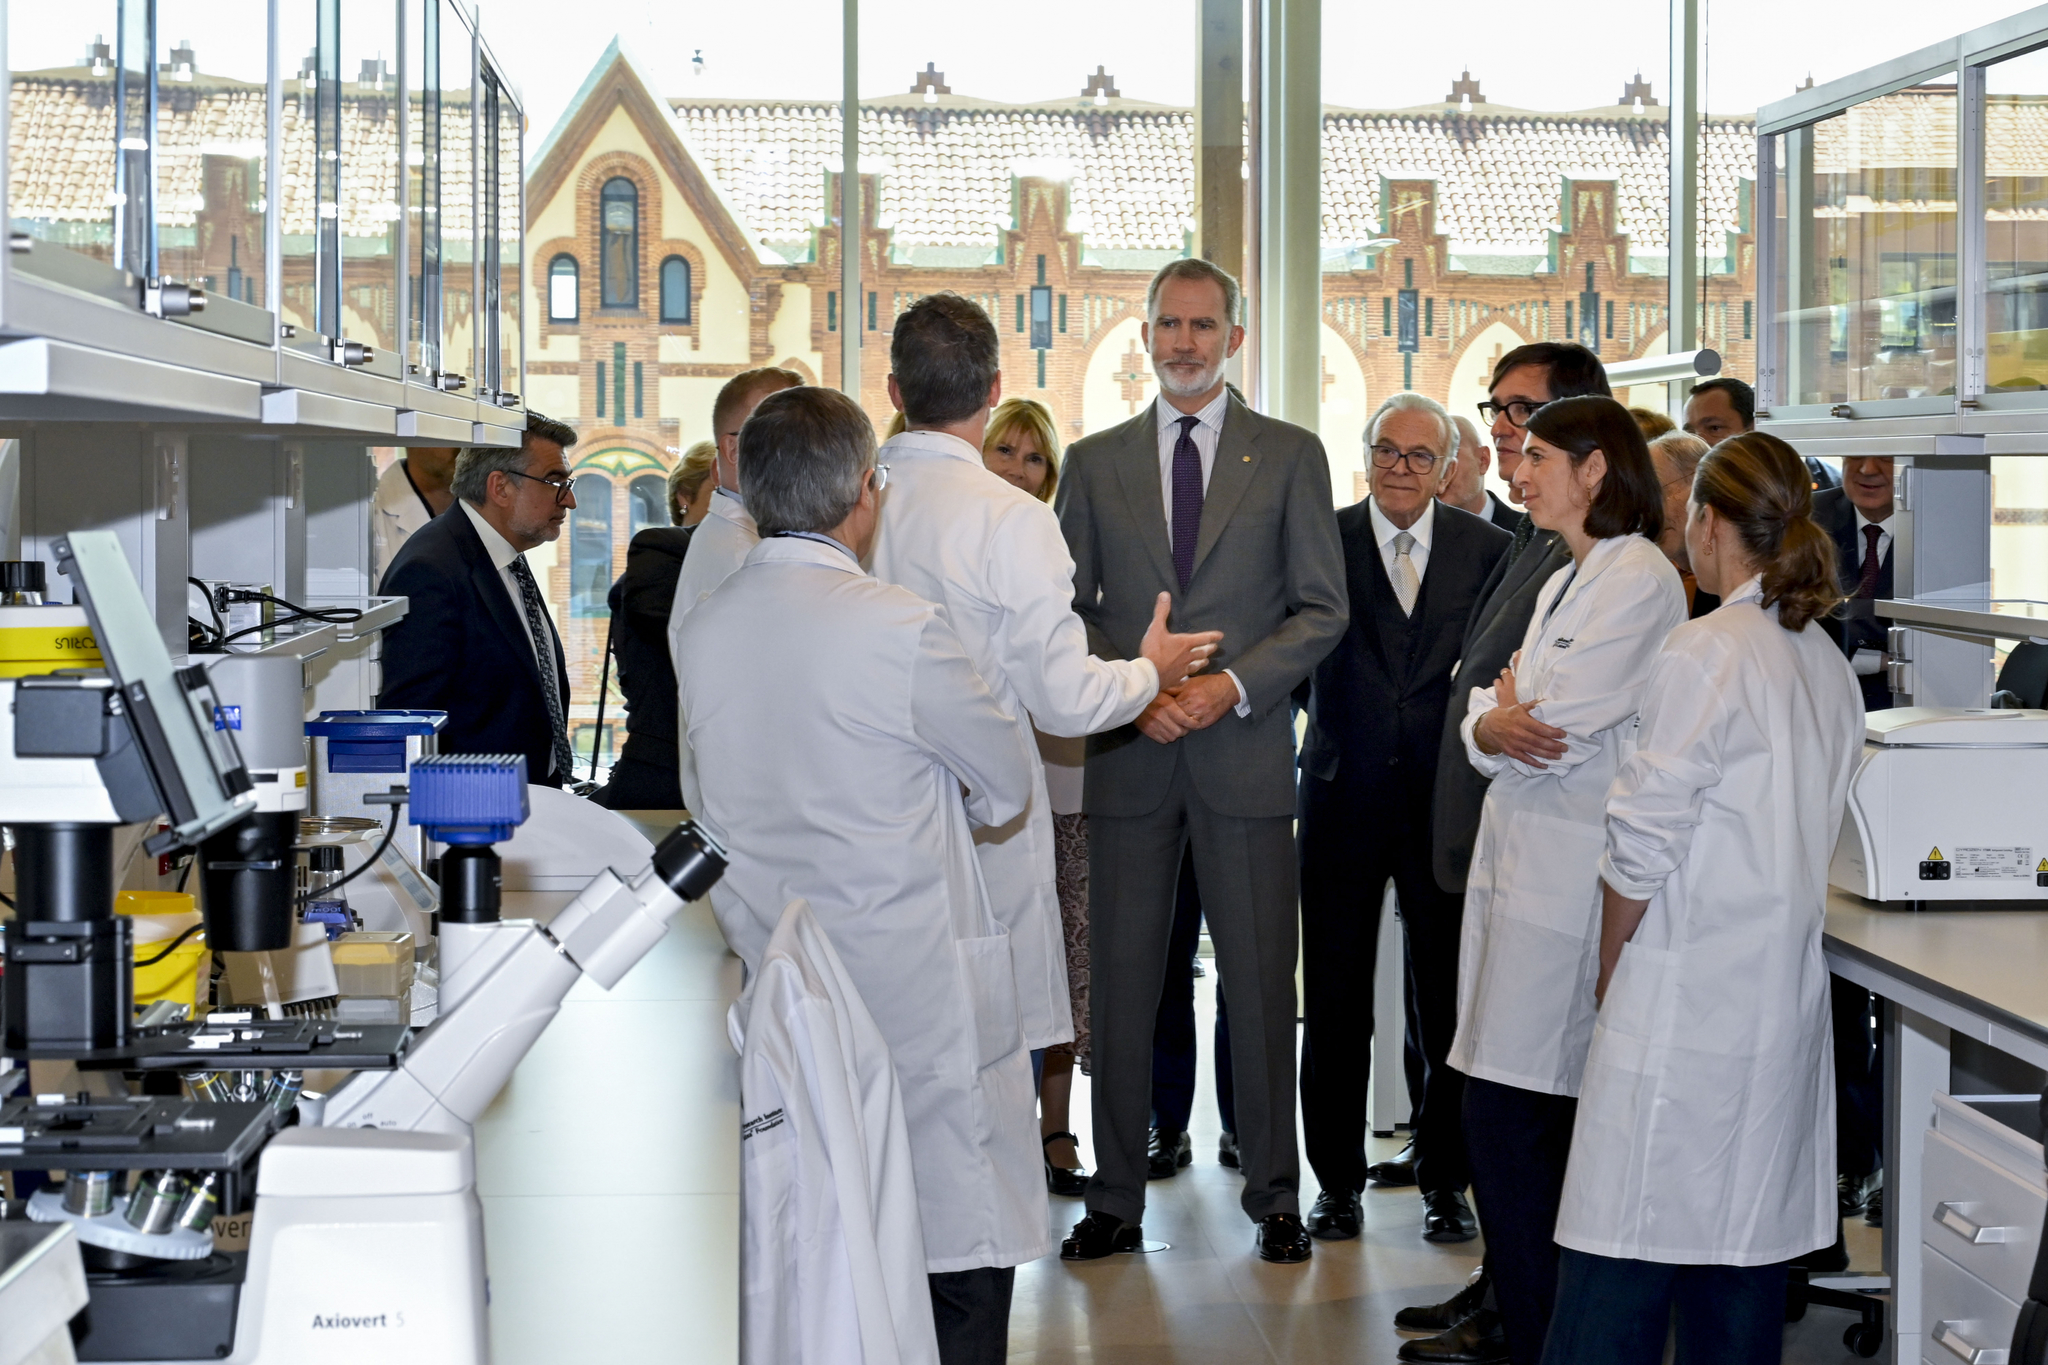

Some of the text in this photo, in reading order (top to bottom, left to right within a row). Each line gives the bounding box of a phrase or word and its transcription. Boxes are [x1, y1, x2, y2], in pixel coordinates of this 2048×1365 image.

[362, 1112, 373, 1120] off
[312, 1311, 405, 1329] Axiovert 5
